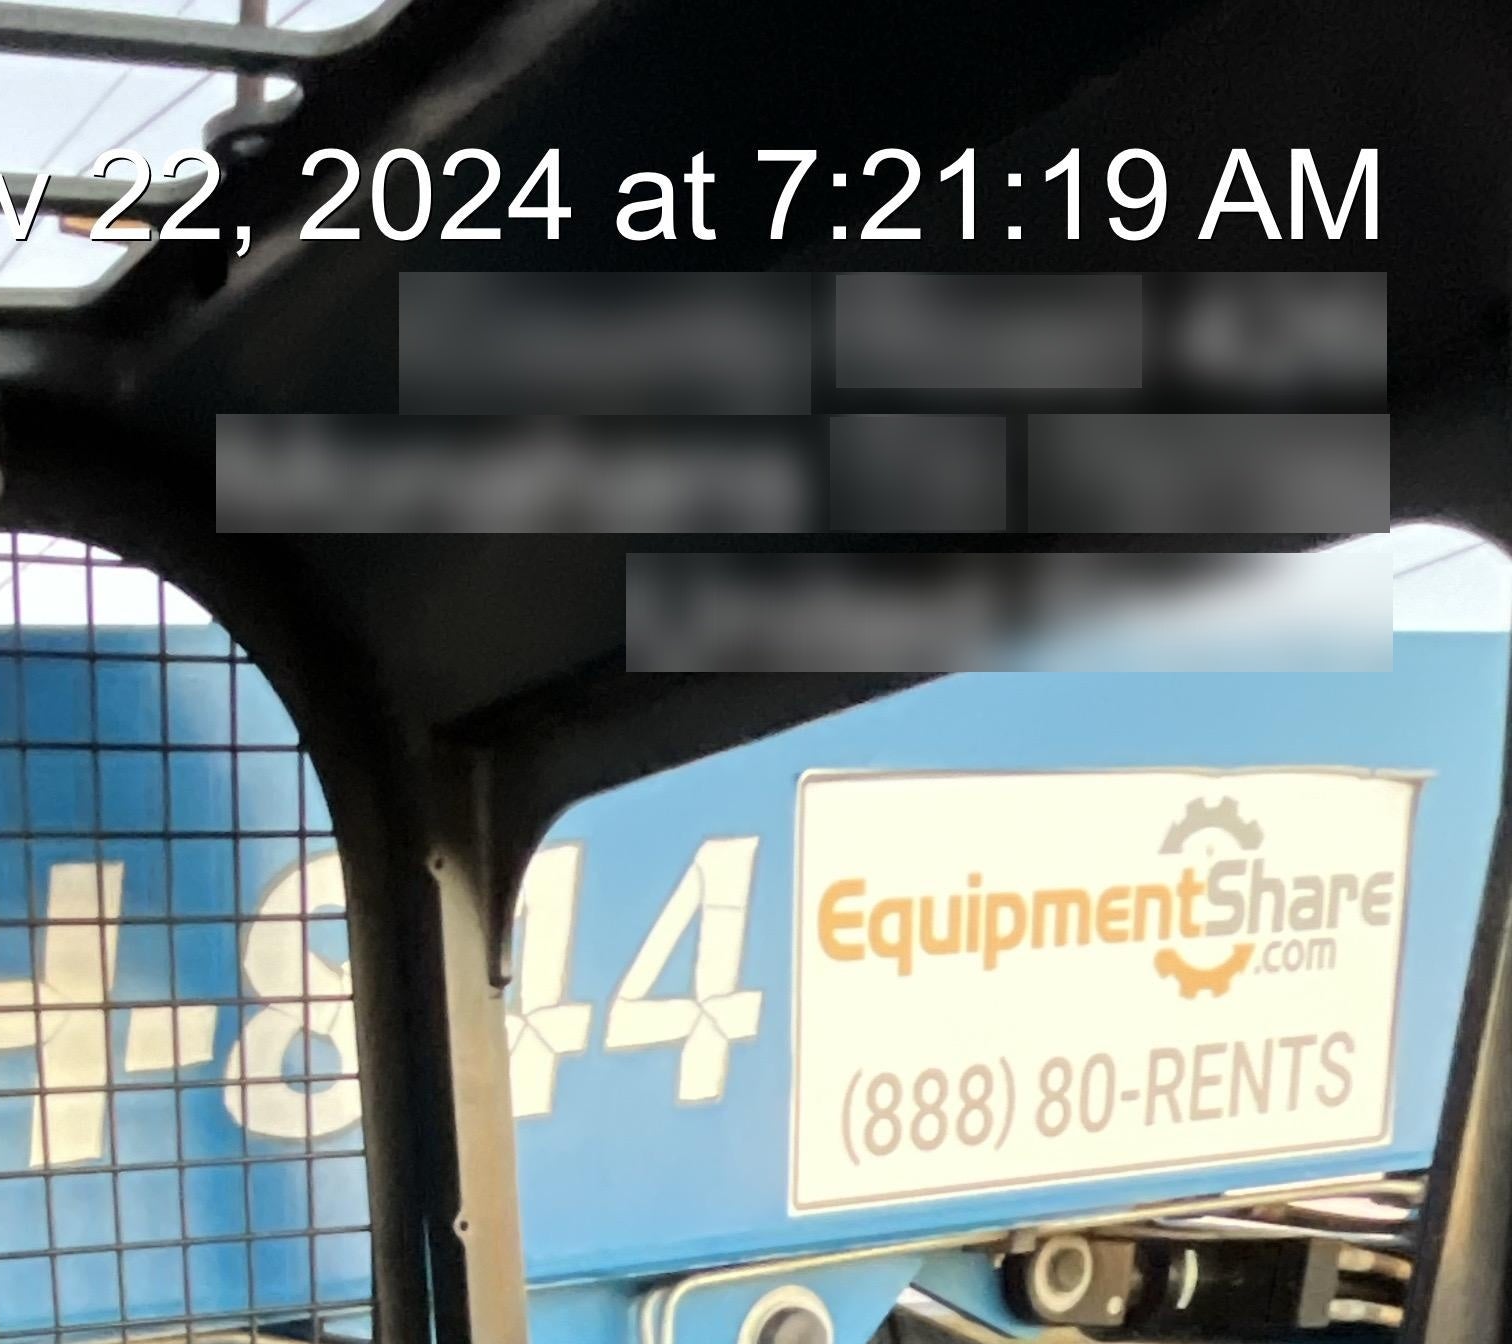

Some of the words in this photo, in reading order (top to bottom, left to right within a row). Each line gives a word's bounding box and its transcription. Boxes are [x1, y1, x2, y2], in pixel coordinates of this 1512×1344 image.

[816, 860, 1396, 976] EquipmentShare
[1253, 936, 1336, 974] .com
[840, 1054, 1016, 1166] (888)
[1036, 1030, 1356, 1138] 80-RENTS
